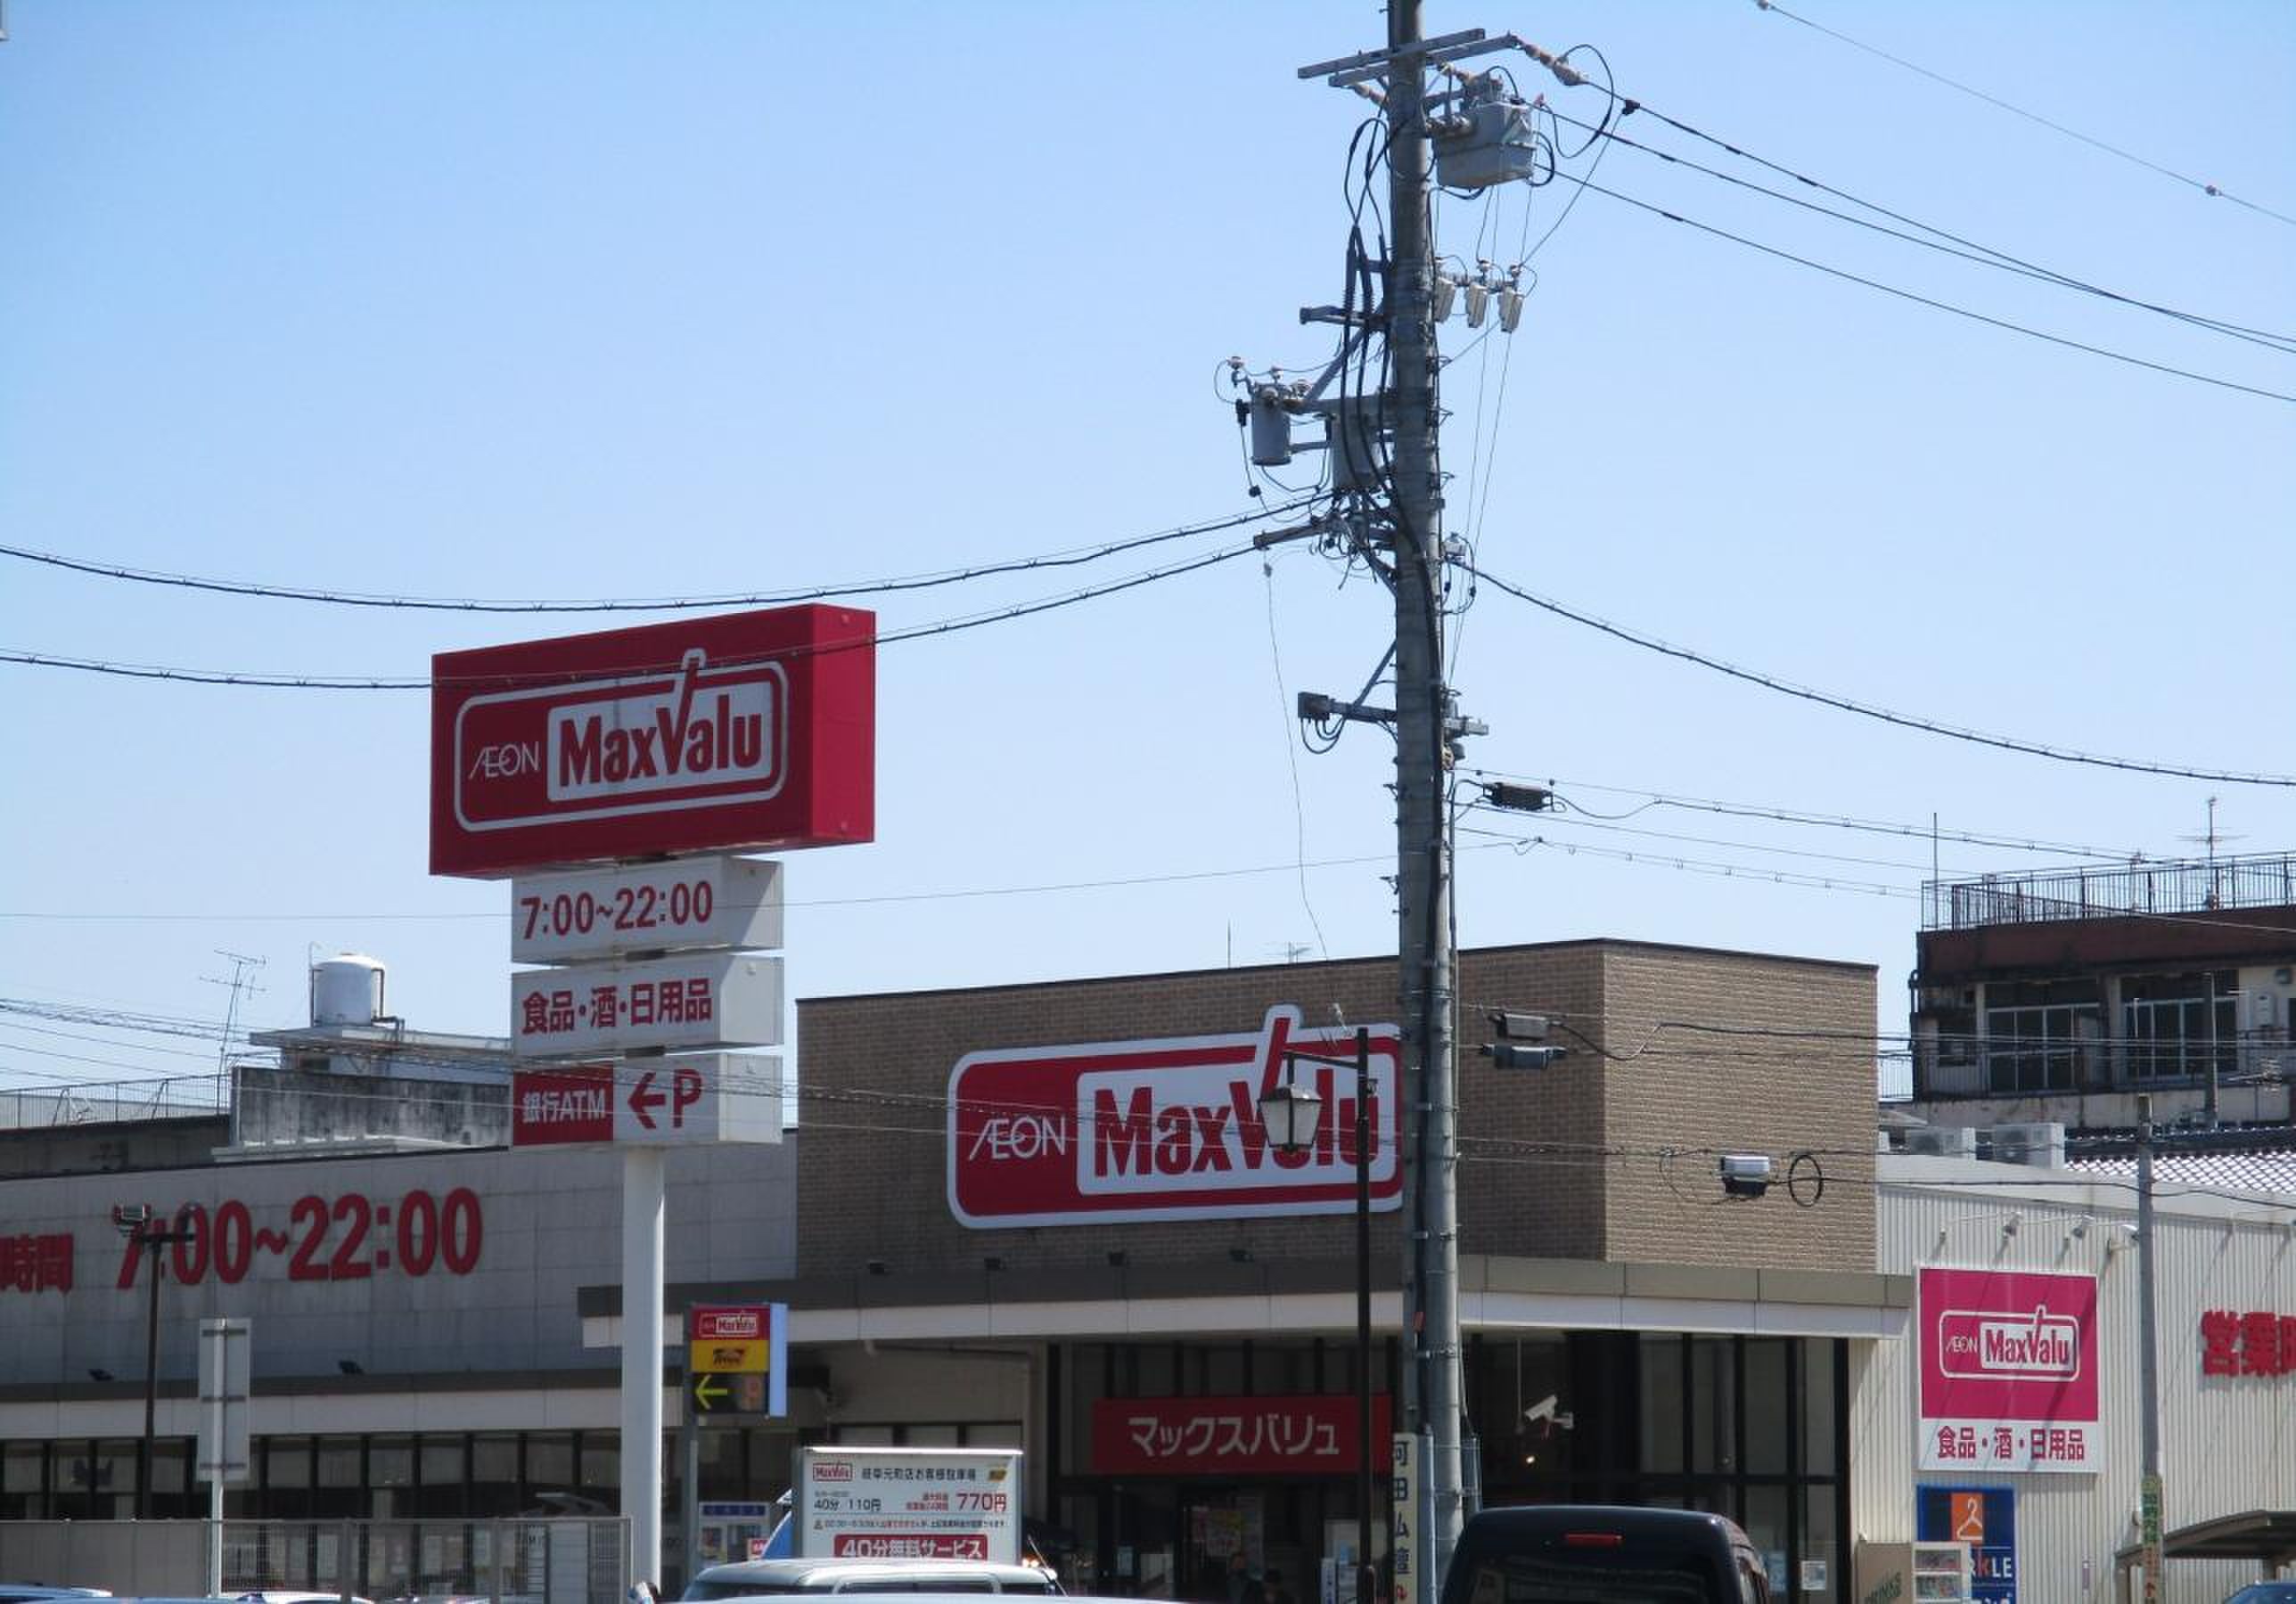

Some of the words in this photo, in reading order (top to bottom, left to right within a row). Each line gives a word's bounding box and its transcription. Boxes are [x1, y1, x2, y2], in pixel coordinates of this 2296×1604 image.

[558, 665, 763, 789] MaxValu
[521, 978, 713, 1036] 食品・酒・日用品
[521, 1086, 607, 1126] 銀行ATM
[672, 1068, 703, 1129] P
[1094, 1018, 1380, 1179] MaxVlu
[1985, 1312, 2070, 1366] MaxValu
[1128, 1413, 1341, 1457] マックスバリュ
[1937, 1425, 2085, 1461] 食品・酒・日用品
[956, 1492, 1007, 1512] 770円
[840, 1538, 983, 1559] 40分無料サービス
